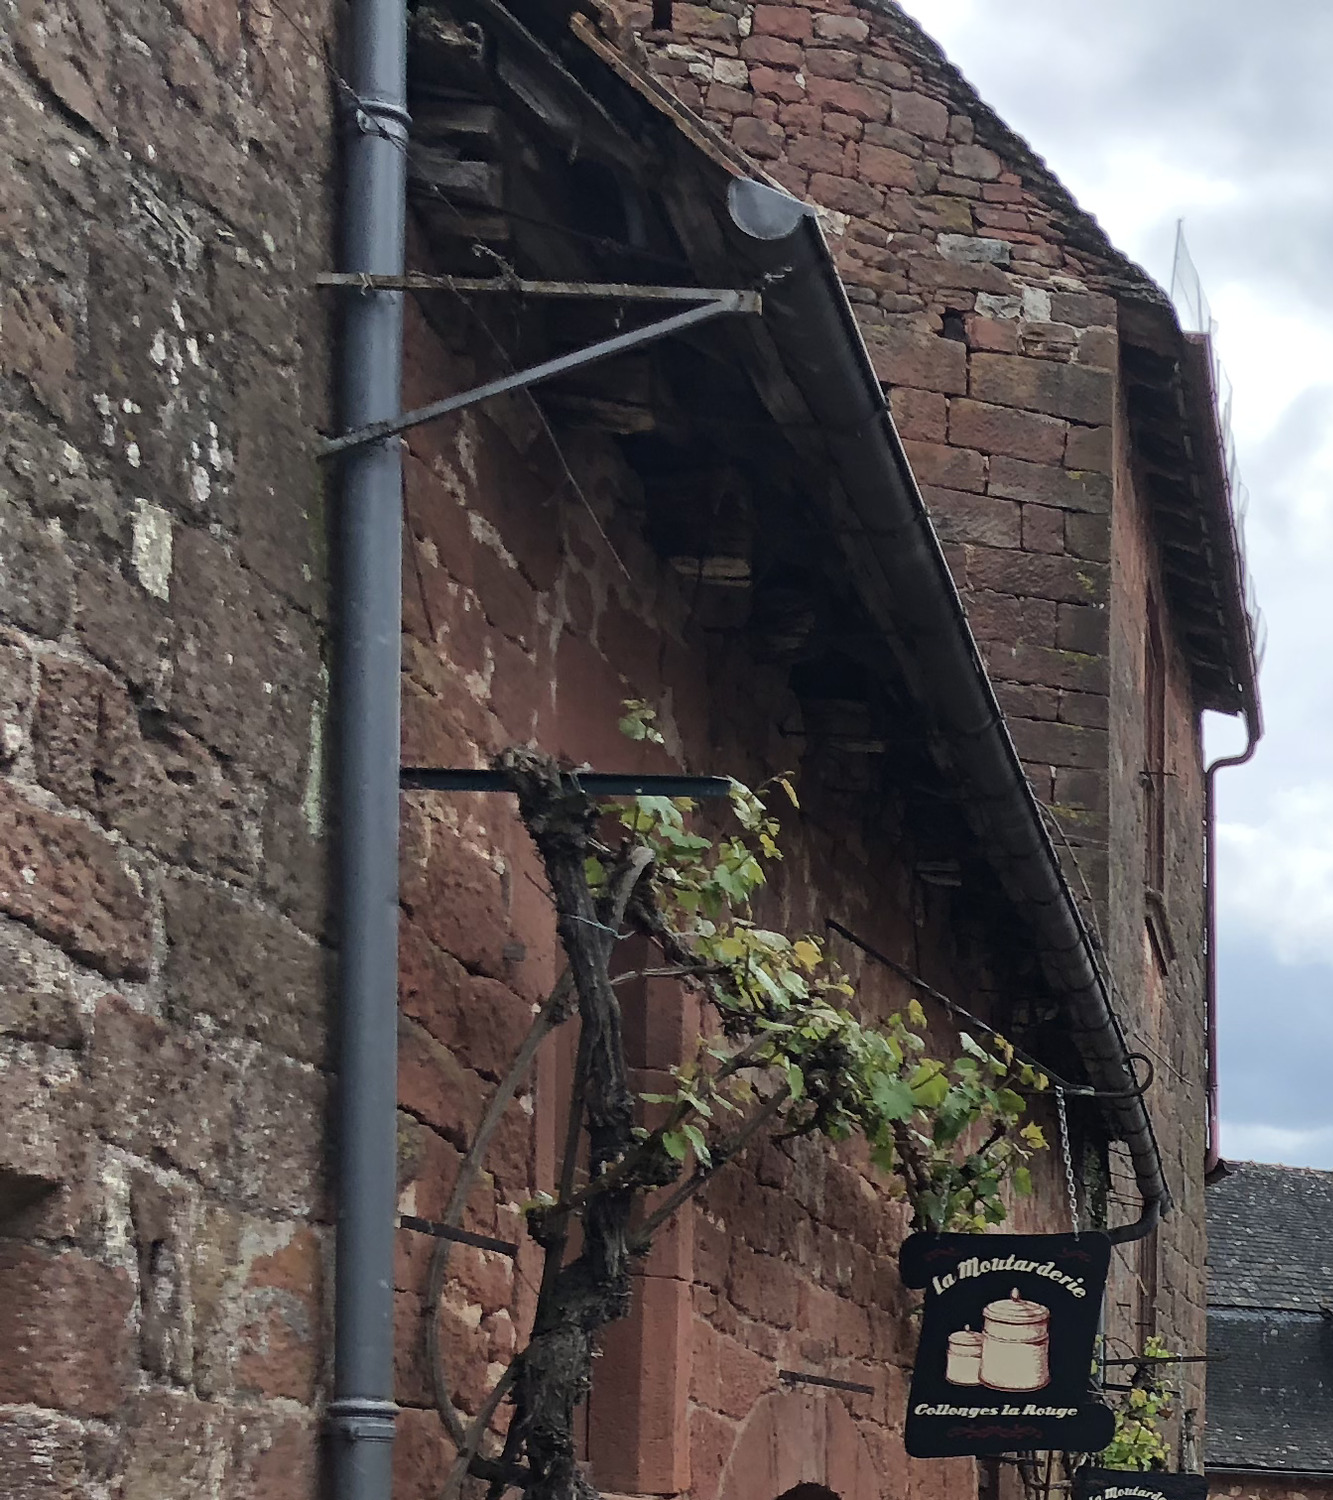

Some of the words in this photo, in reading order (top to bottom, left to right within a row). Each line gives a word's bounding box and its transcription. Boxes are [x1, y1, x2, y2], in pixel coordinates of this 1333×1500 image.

[957, 1254, 1086, 1298] Moutarderie
[914, 1403, 999, 1418] Collonges
[1000, 1404, 1021, 1416] la
[1022, 1404, 1078, 1419] Rouge
